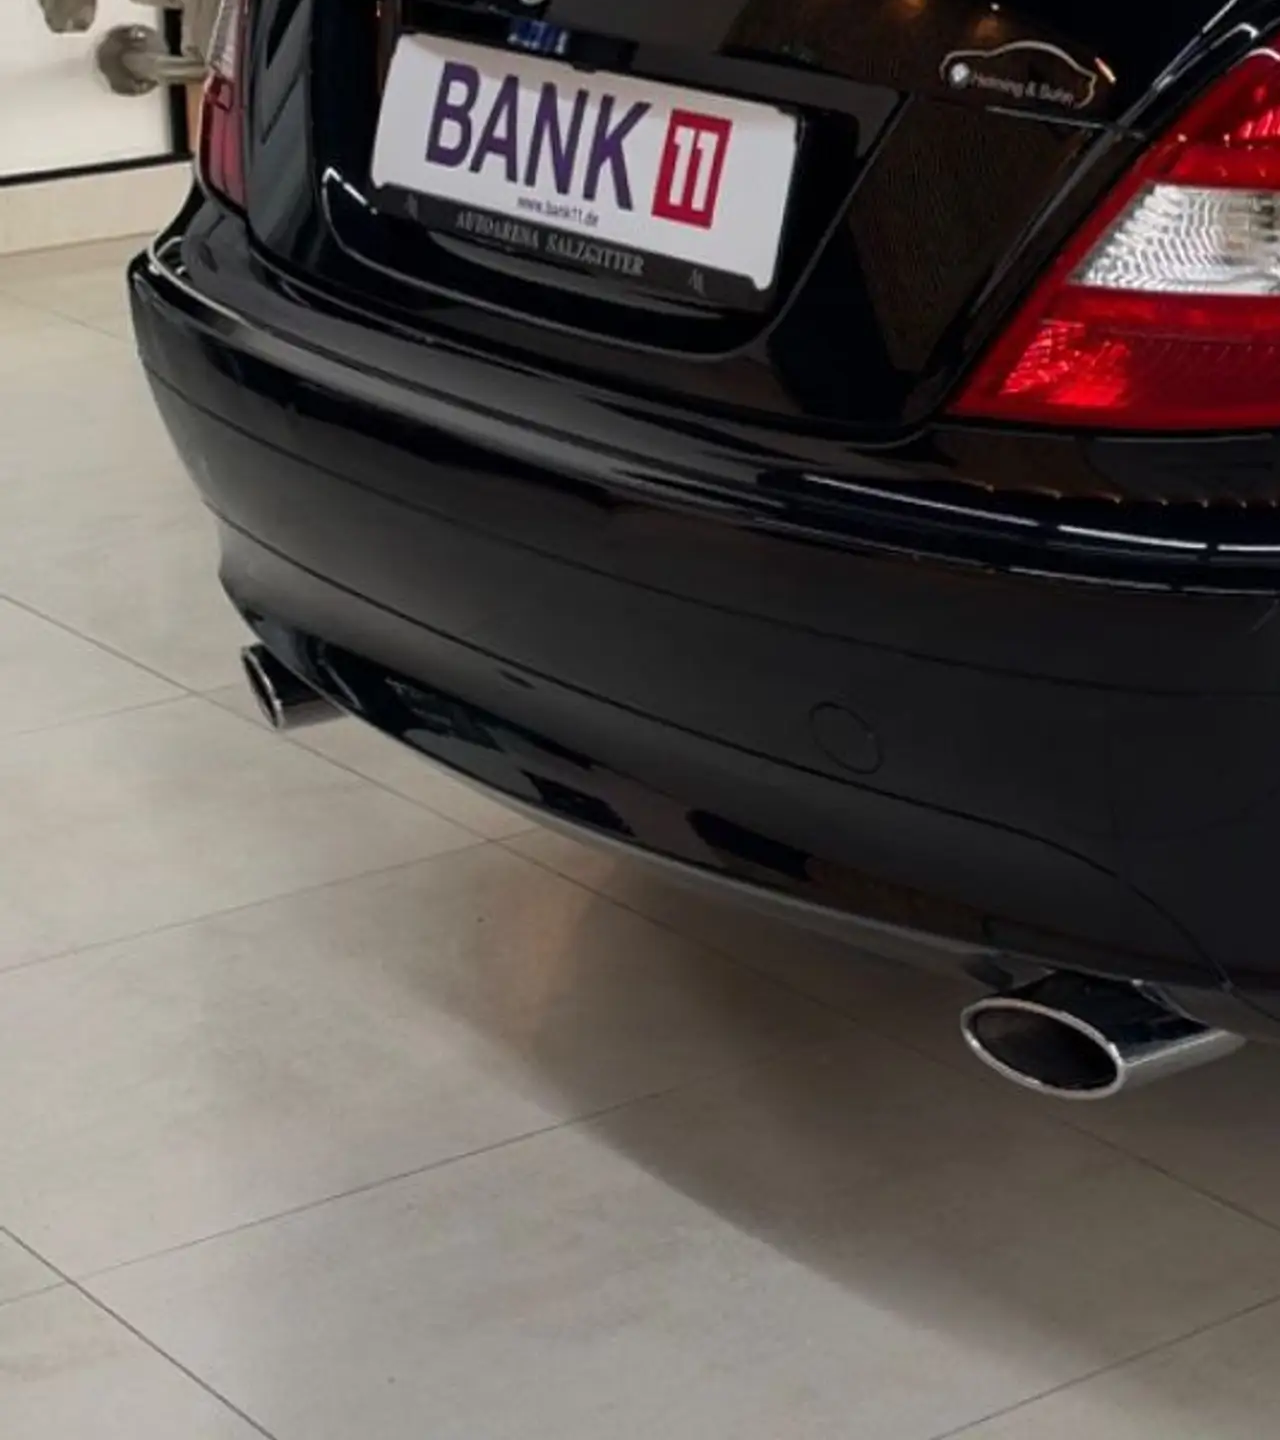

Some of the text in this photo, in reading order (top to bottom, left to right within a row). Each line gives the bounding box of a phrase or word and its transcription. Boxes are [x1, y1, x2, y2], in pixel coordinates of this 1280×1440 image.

[426, 60, 720, 212] BANK 11
[456, 211, 645, 277] AUTOARENA SALZGITTER
[516, 196, 599, 227] www.bank11.de
